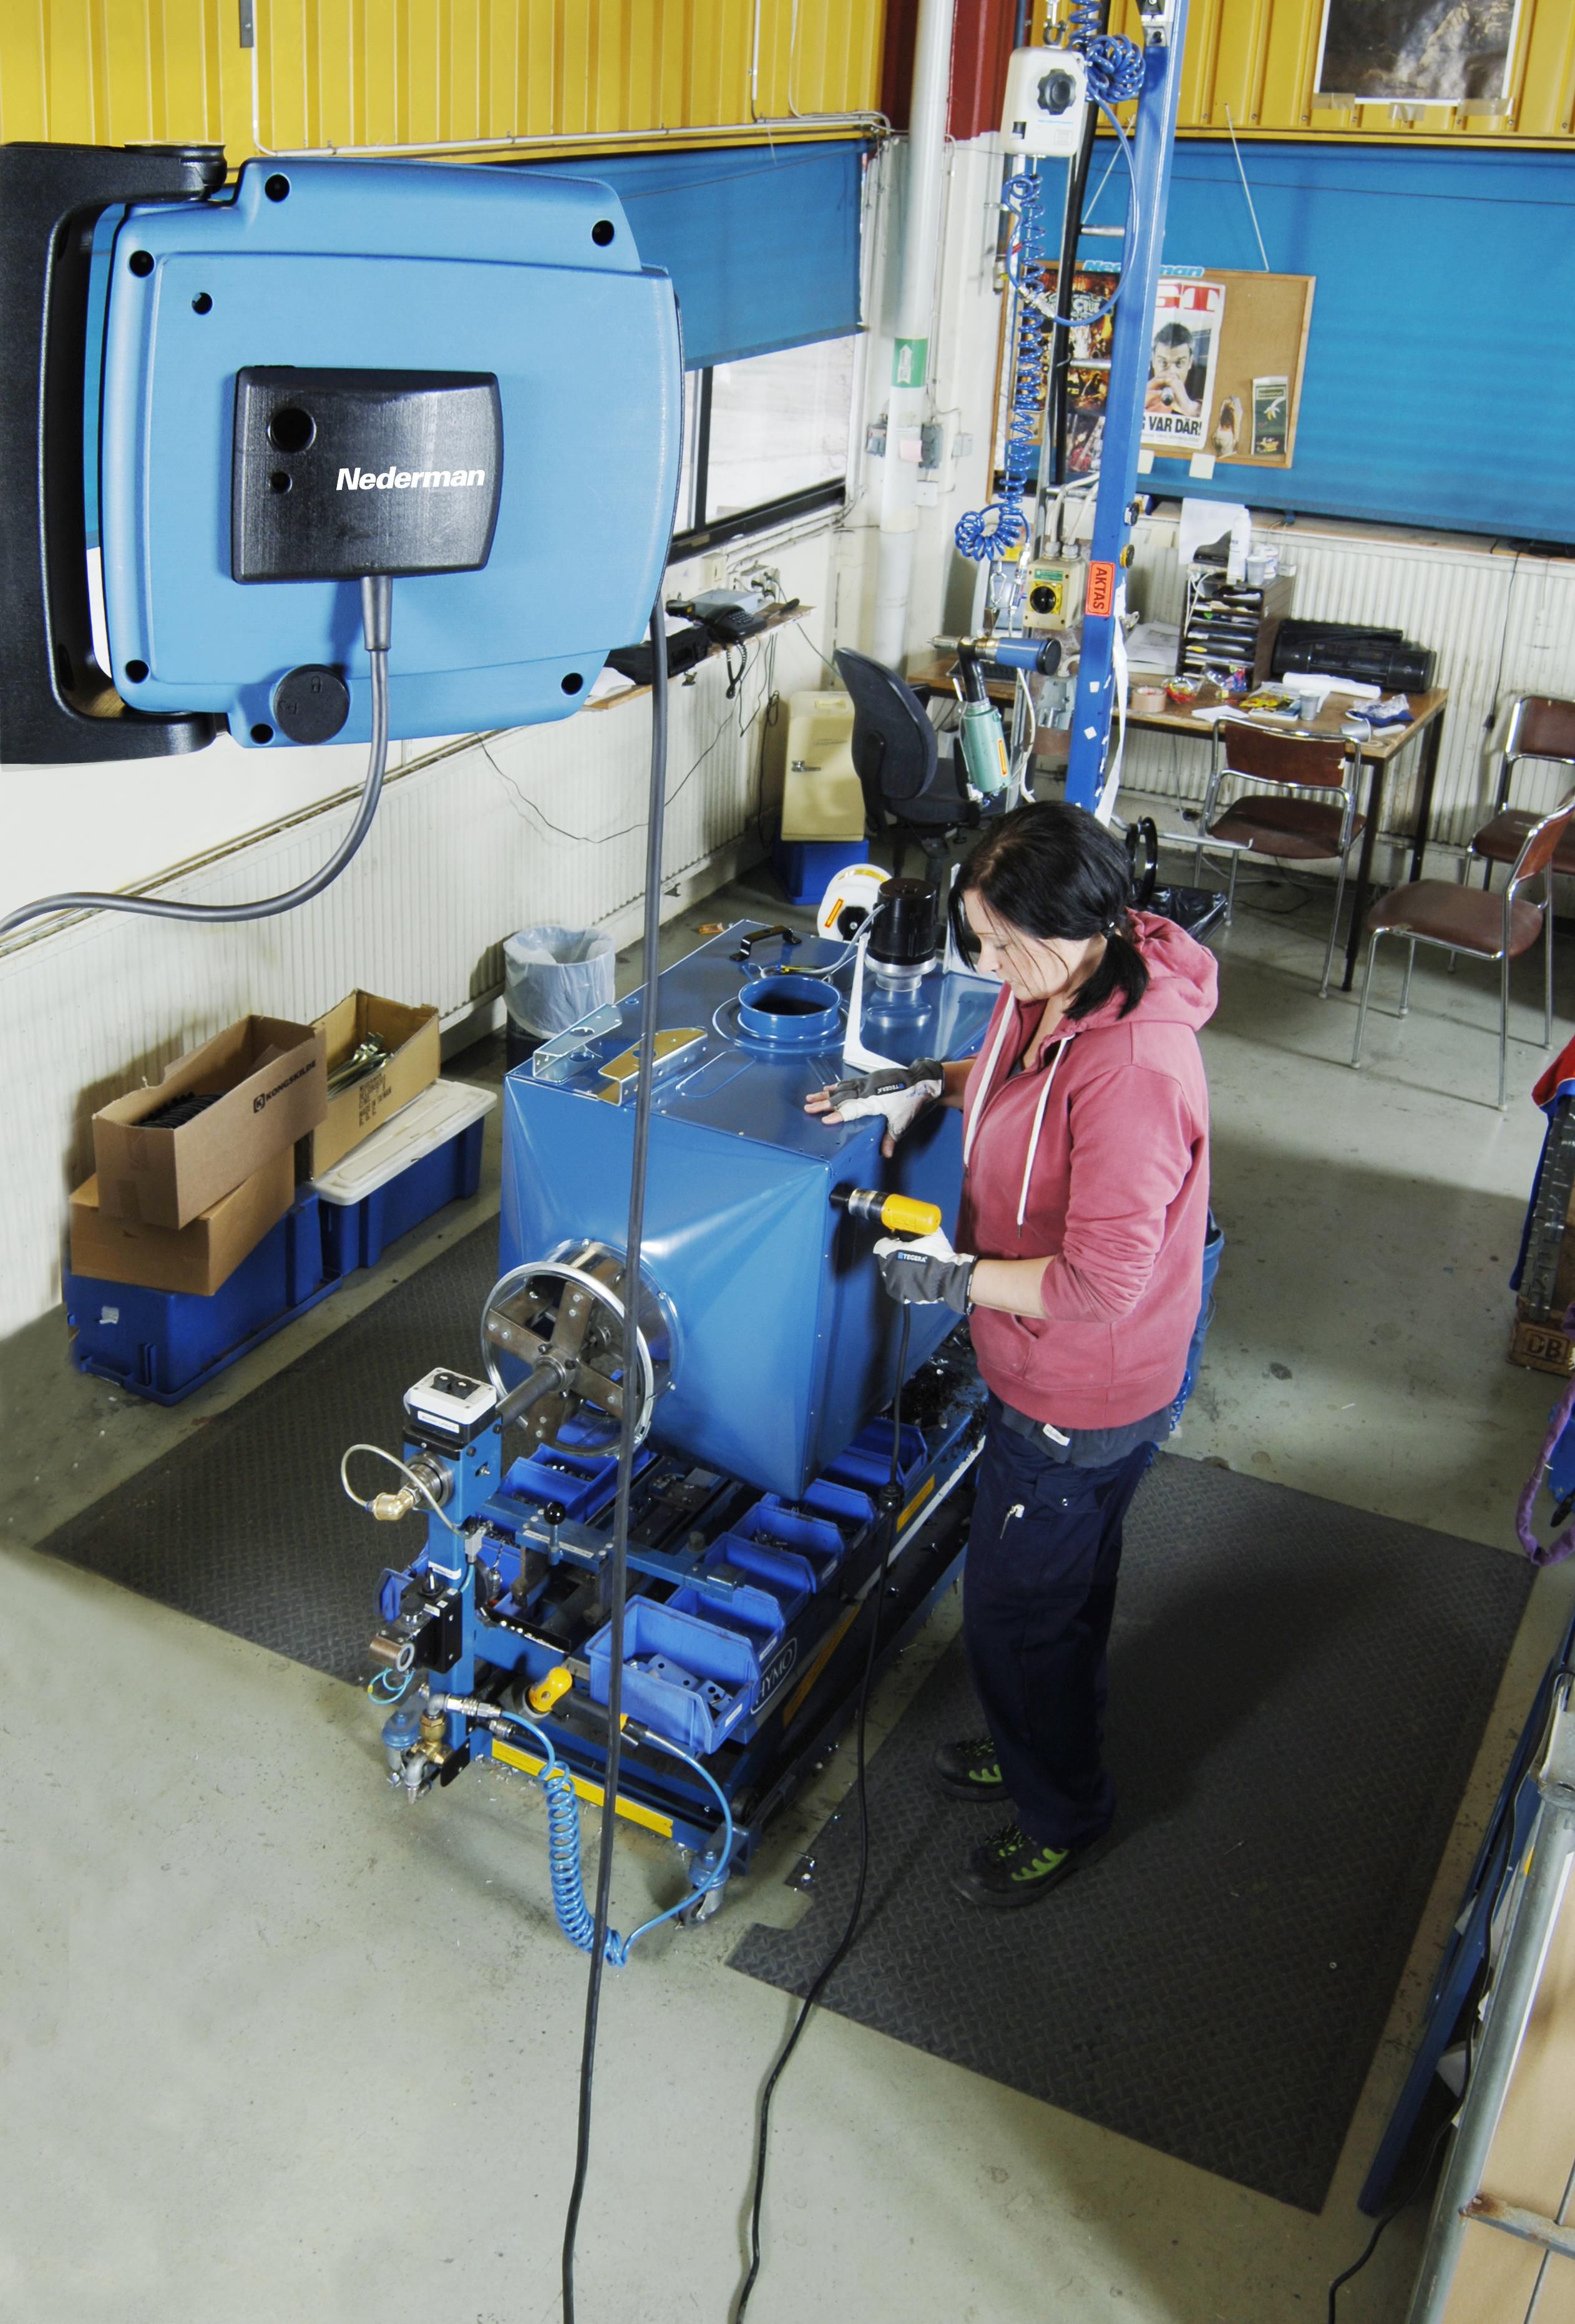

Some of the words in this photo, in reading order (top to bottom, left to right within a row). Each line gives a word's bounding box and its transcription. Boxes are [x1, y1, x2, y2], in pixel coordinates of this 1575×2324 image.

[1149, 416, 1173, 432] VAR
[1175, 418, 1202, 436] DÄR!
[336, 466, 485, 491] Nederman
[1093, 567, 1108, 610] AKTAS
[266, 1058, 316, 1101] KONGSKILDE
[1527, 1333, 1563, 1359] DB
[756, 1649, 792, 1704] HYMO
